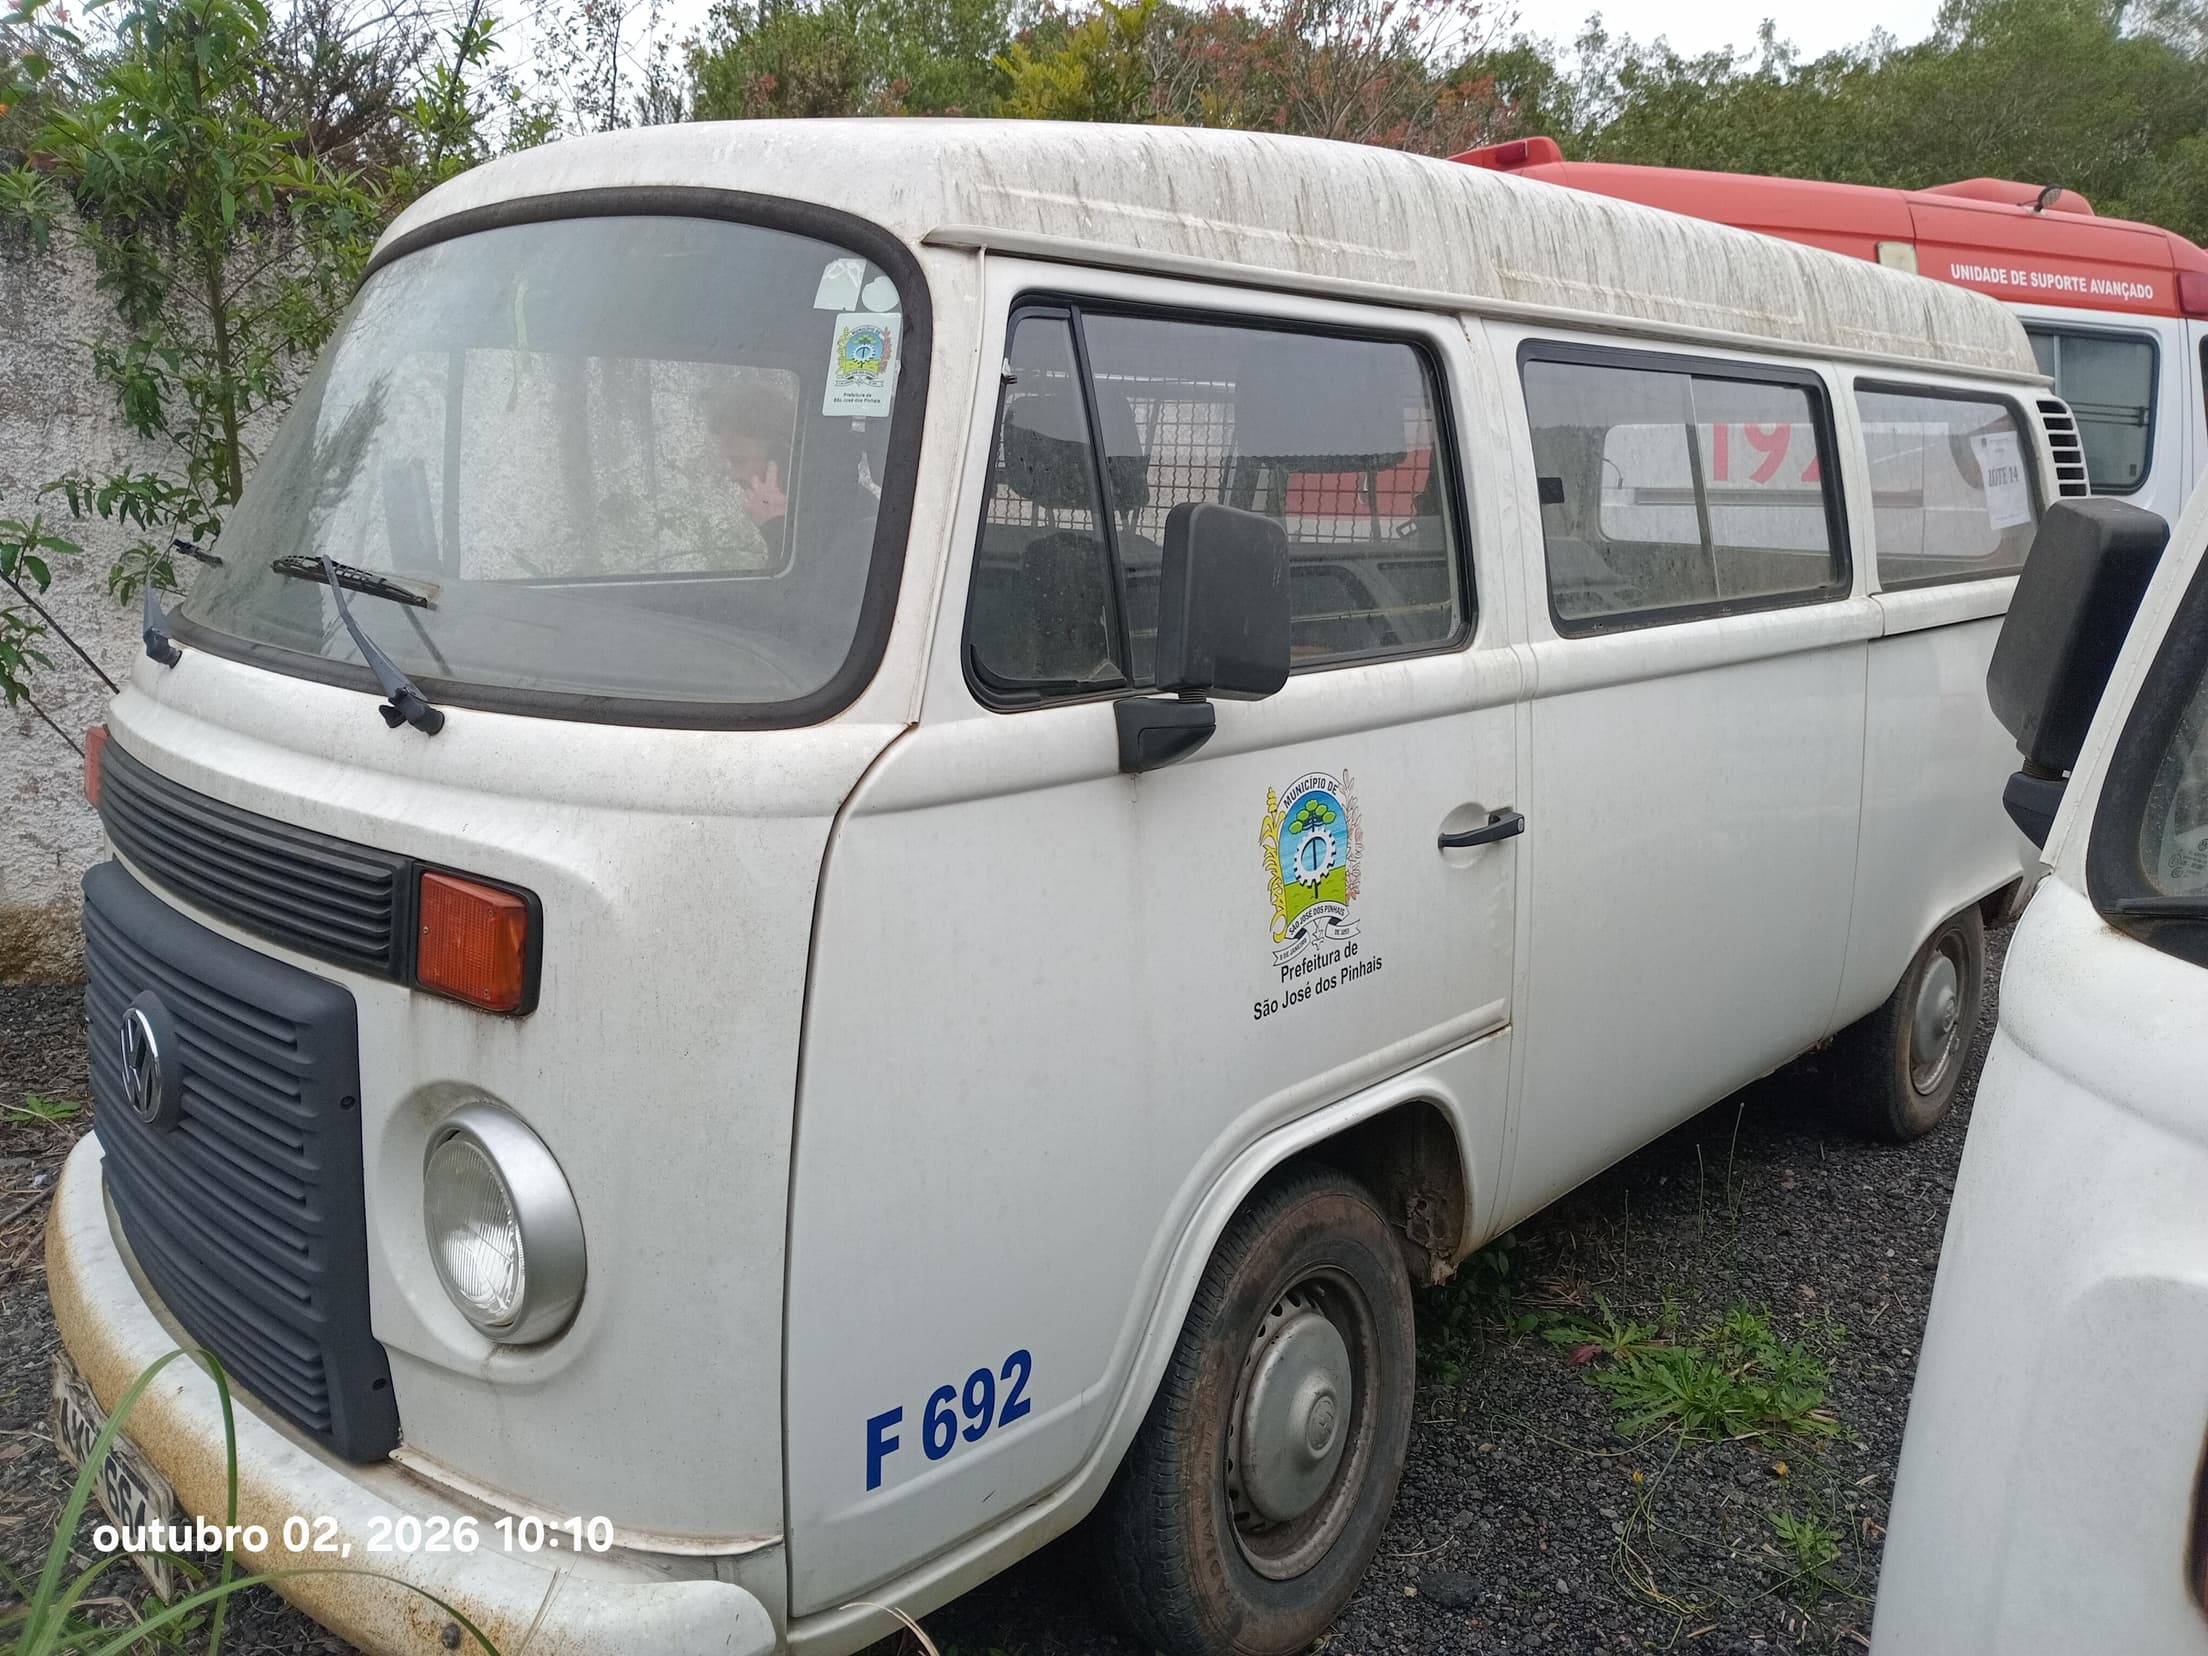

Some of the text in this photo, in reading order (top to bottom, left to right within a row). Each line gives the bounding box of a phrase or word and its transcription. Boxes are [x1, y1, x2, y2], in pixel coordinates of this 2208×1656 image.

[1950, 263, 2154, 301] UNIDADE DE SUPORTE AVANÇADO
[1988, 466, 2008, 487] LOTE
[1284, 776, 1339, 808] MUNICÍPIO DE
[1313, 905, 1324, 915] DOS
[1324, 904, 1345, 916] PINHAIS
[1281, 941, 1358, 983] Prefeitura de
[1254, 956, 1382, 1020] São José dos Pinhais
[866, 1349, 1032, 1492] F 692
